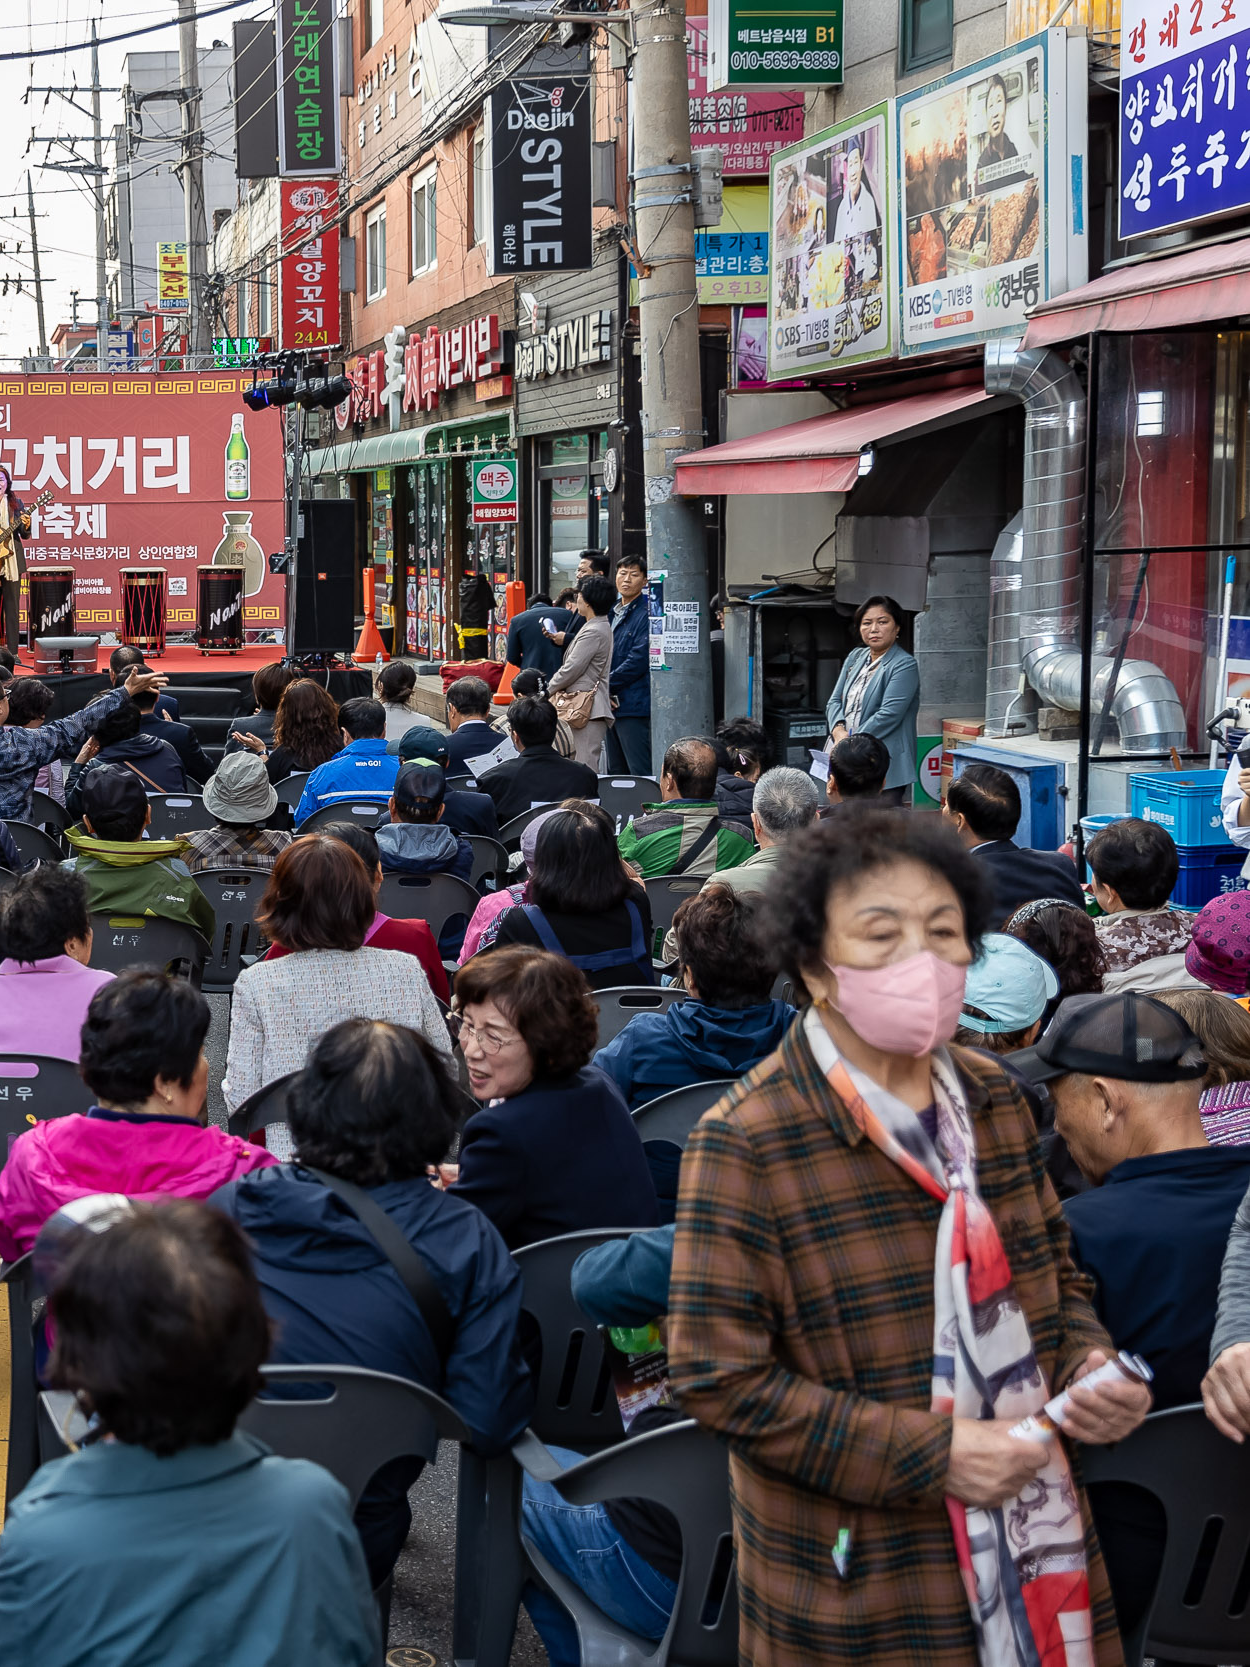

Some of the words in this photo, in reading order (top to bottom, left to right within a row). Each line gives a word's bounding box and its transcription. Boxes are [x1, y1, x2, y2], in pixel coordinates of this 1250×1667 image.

[737, 28, 807, 44] 베트남음식점
[816, 26, 837, 43] B1
[731, 50, 841, 70] 010-5696-9889
[291, 0, 325, 160] 노래연습장
[507, 109, 575, 131] Daejin
[521, 138, 562, 266] STYLE
[502, 223, 516, 266] 헤어샵
[161, 256, 185, 298] 부동산
[909, 294, 932, 318] KBS
[294, 331, 328, 345] 24시
[515, 336, 546, 381] Daejin
[547, 309, 601, 376] STYLE
[438, 315, 498, 391] 샤브샤브
[480, 471, 510, 487] 맥주
[475, 507, 516, 518] 해월양꼬치
[138, 545, 198, 560] 상인연합회
[665, 603, 698, 613] 신축아파트
